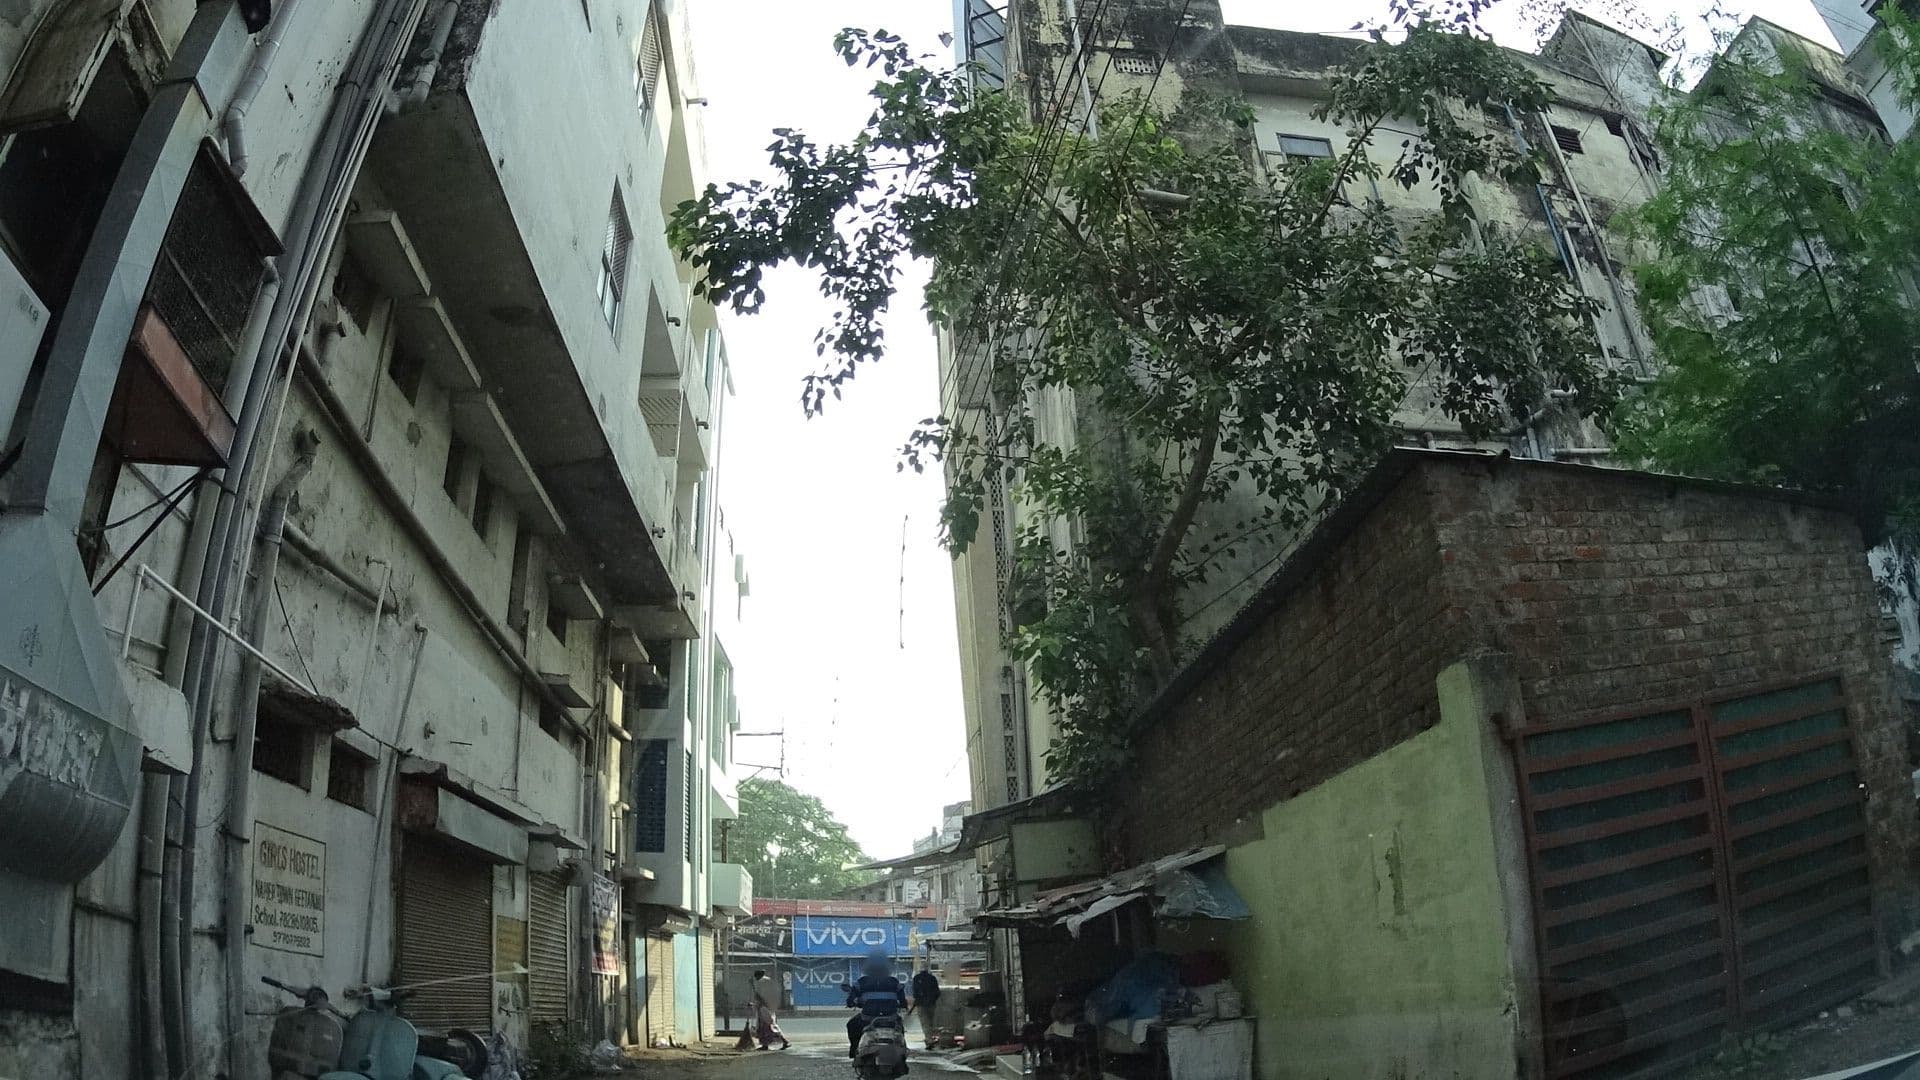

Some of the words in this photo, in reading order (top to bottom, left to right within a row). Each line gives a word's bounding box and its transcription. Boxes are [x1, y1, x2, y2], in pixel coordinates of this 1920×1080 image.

[260, 840, 287, 871] GIRLS
[290, 848, 321, 880] HOSTEL
[807, 921, 886, 945] vivo
[795, 968, 844, 983] vivo
